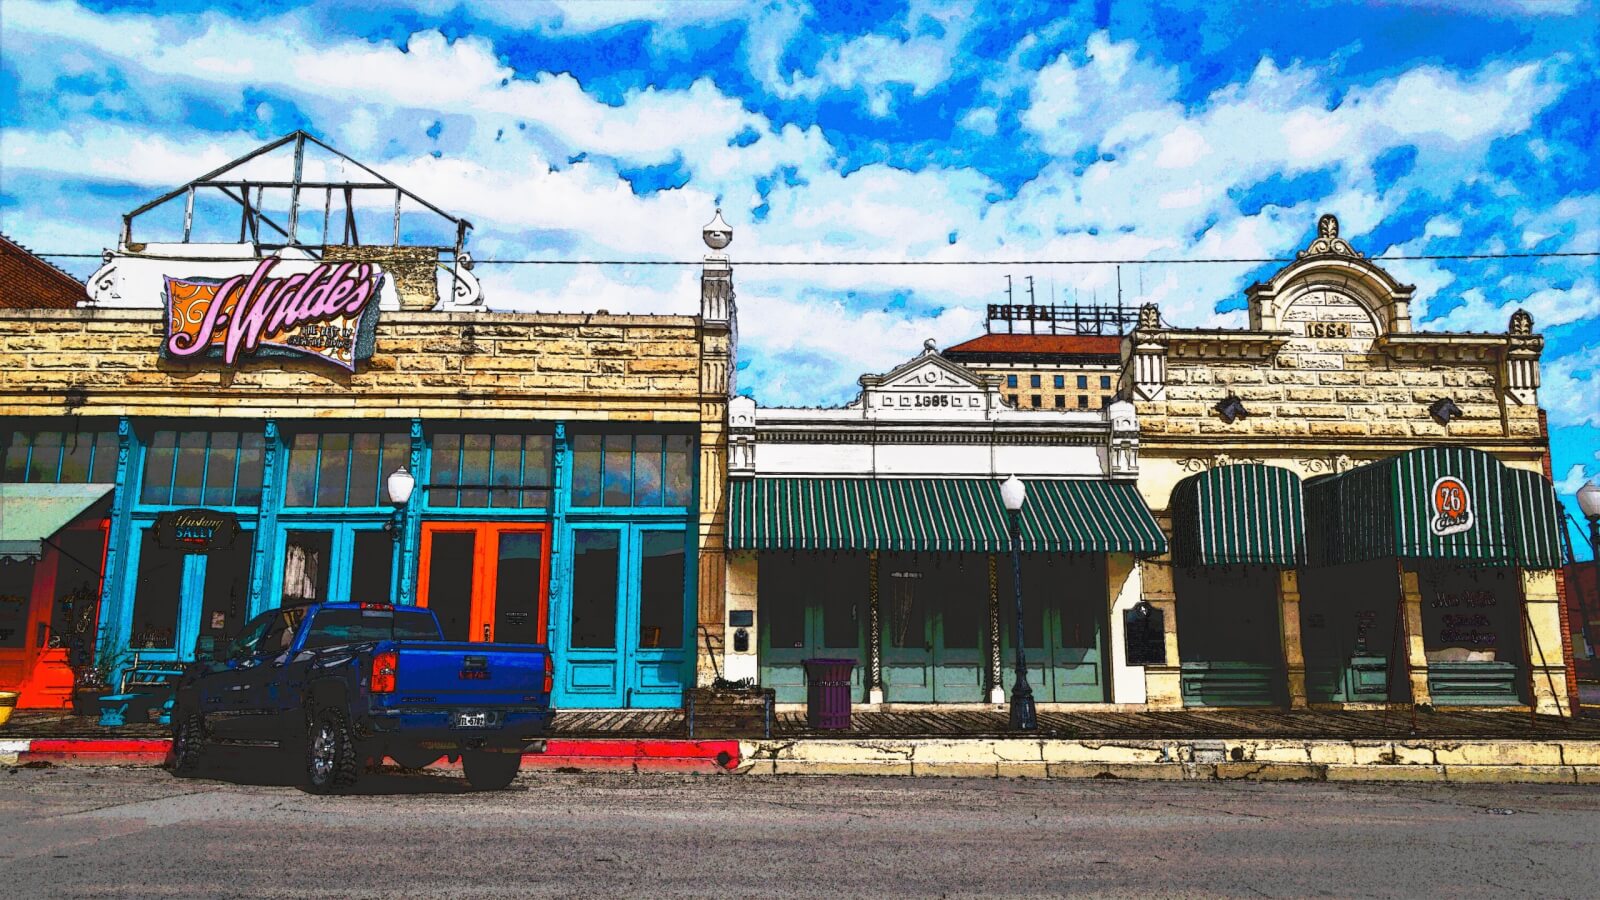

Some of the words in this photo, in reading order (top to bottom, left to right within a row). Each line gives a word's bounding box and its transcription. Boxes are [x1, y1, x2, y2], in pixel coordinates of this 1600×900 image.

[1441, 487, 1461, 511] 26
[169, 515, 224, 532] Mustang
[176, 527, 214, 538] SALLY
